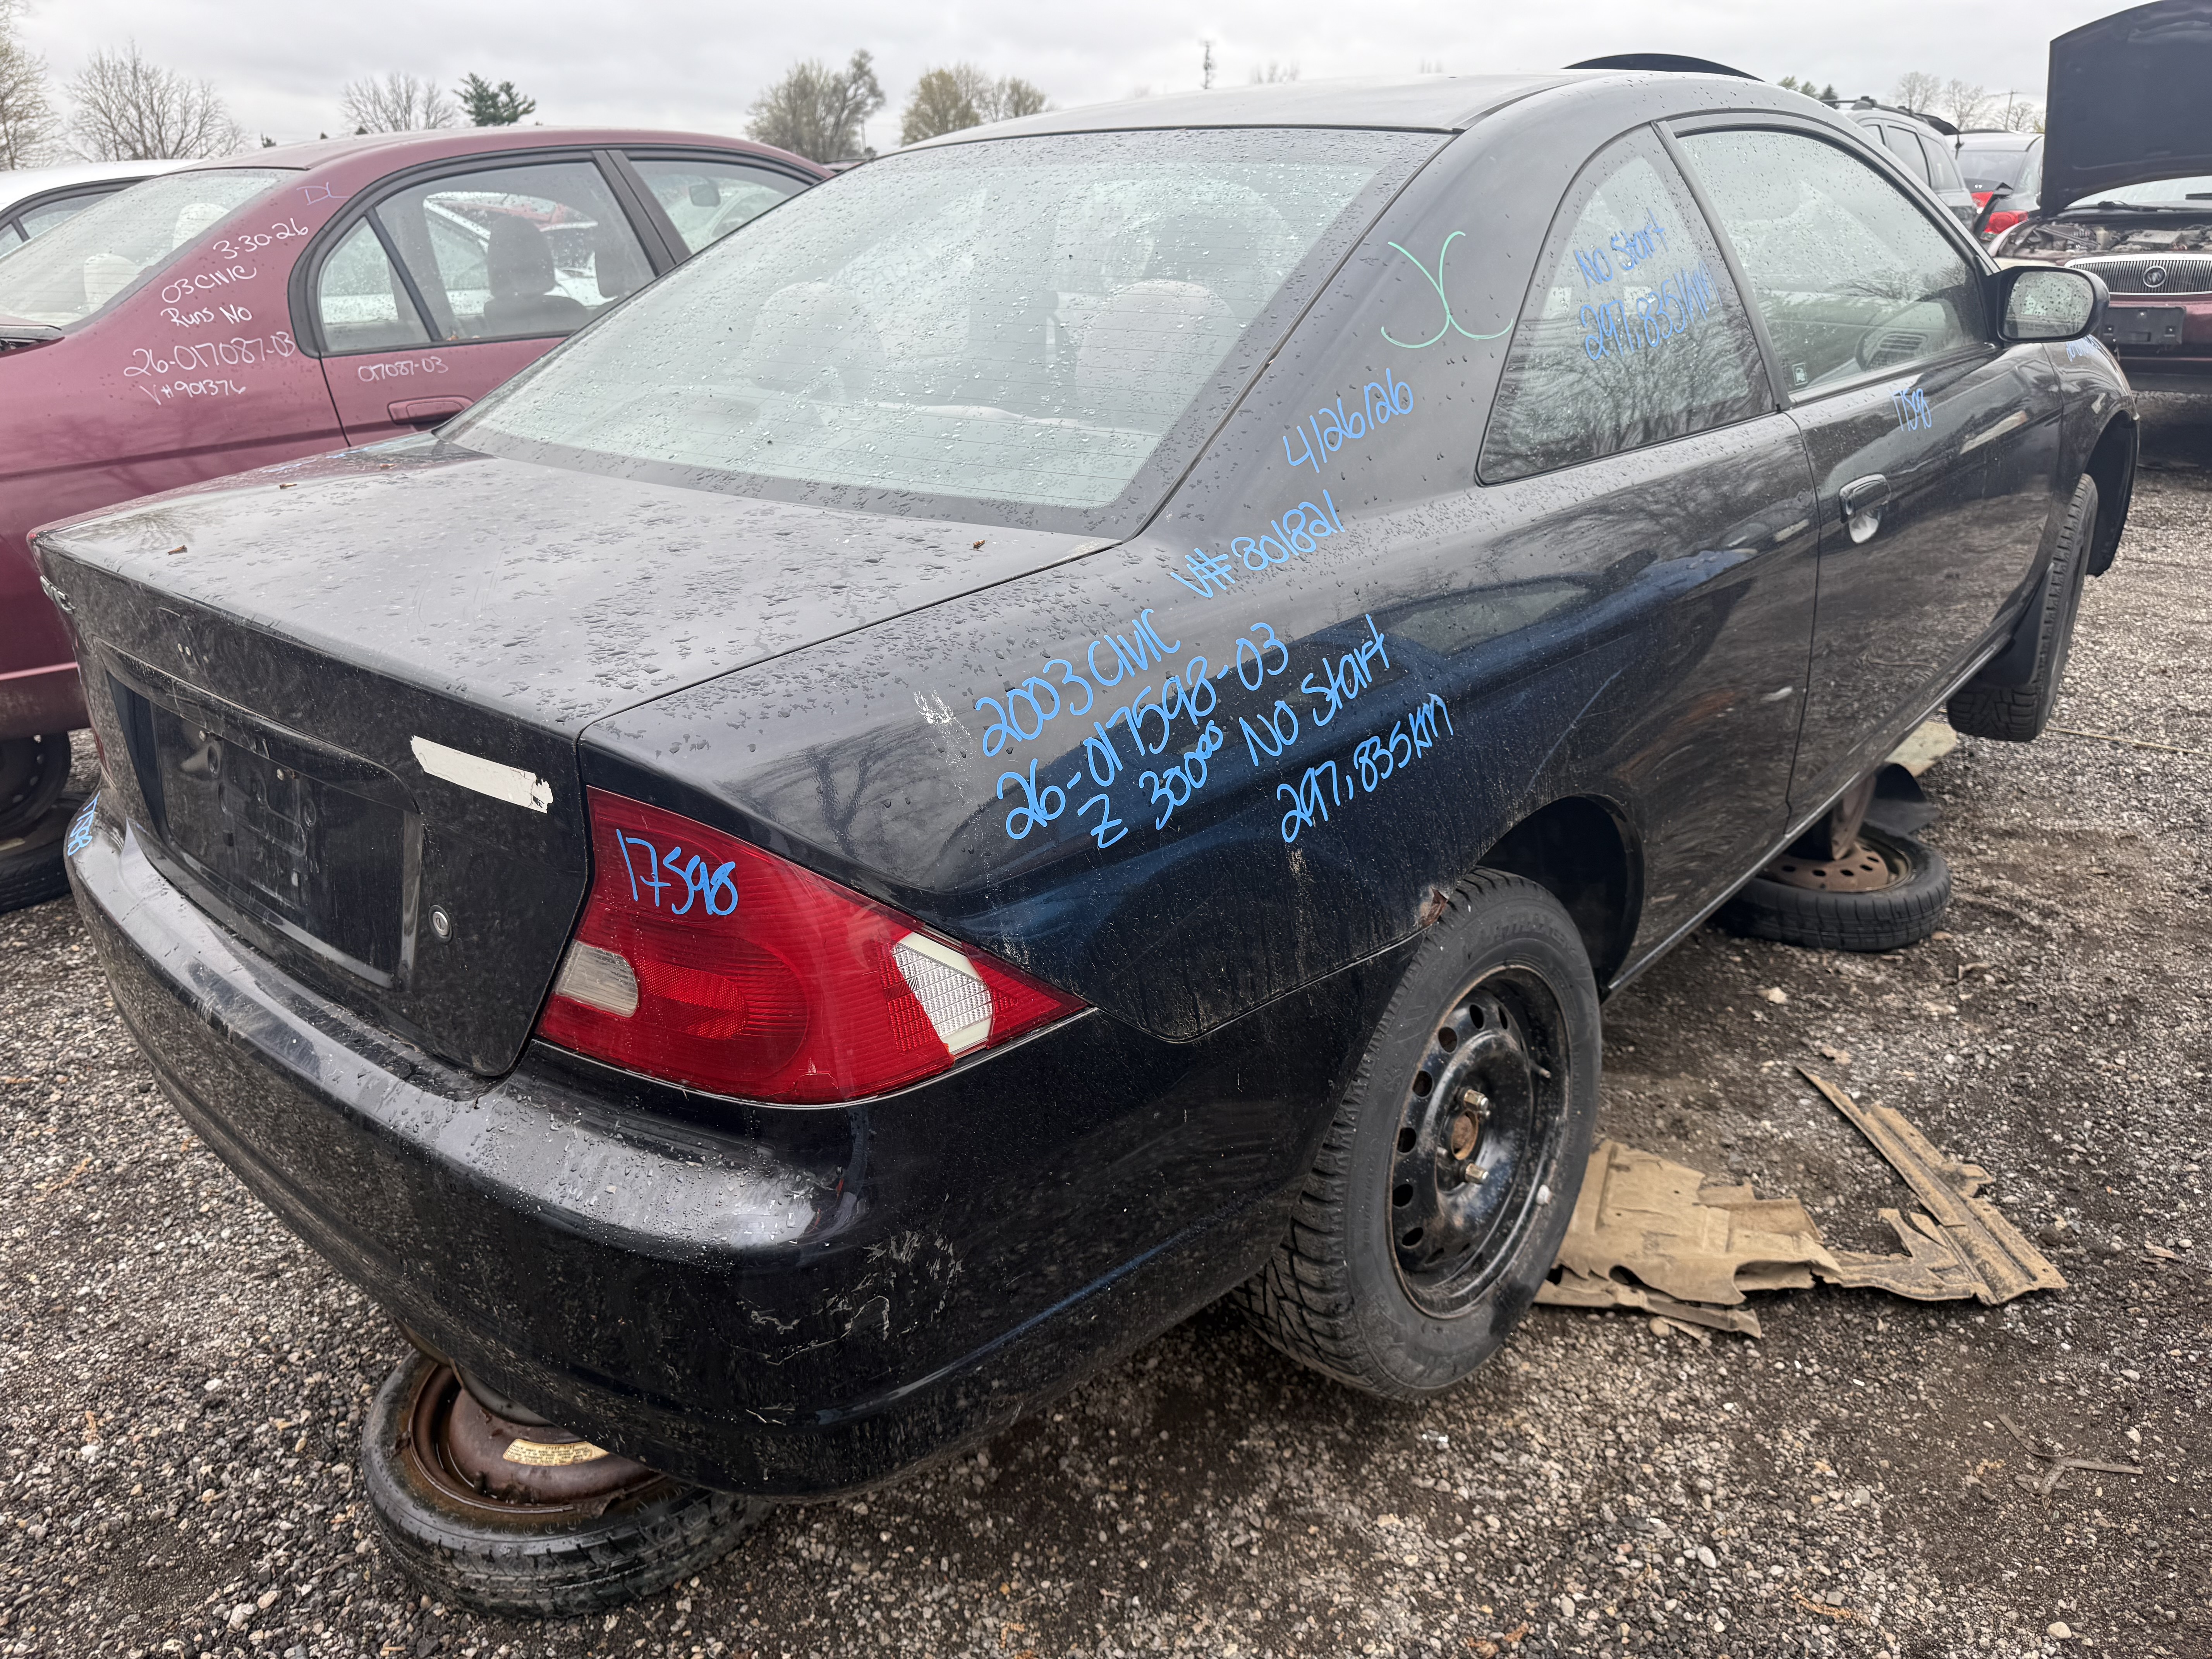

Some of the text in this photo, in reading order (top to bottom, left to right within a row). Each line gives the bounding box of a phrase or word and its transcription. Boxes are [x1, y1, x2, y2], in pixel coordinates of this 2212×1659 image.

[213, 218, 309, 259] 3-30-26
[1611, 208, 1669, 271] Start
[124, 331, 295, 377] 26-017087-03
[160, 307, 214, 328] Runs
[358, 356, 449, 382] 017087-03
[1282, 368, 1413, 473] 4/26/26
[975, 608, 1181, 757] 2003 CIVIC
[1301, 613, 1390, 726] Start
[996, 622, 1289, 840] 26-017598-03
[616, 829, 738, 915] 17598
